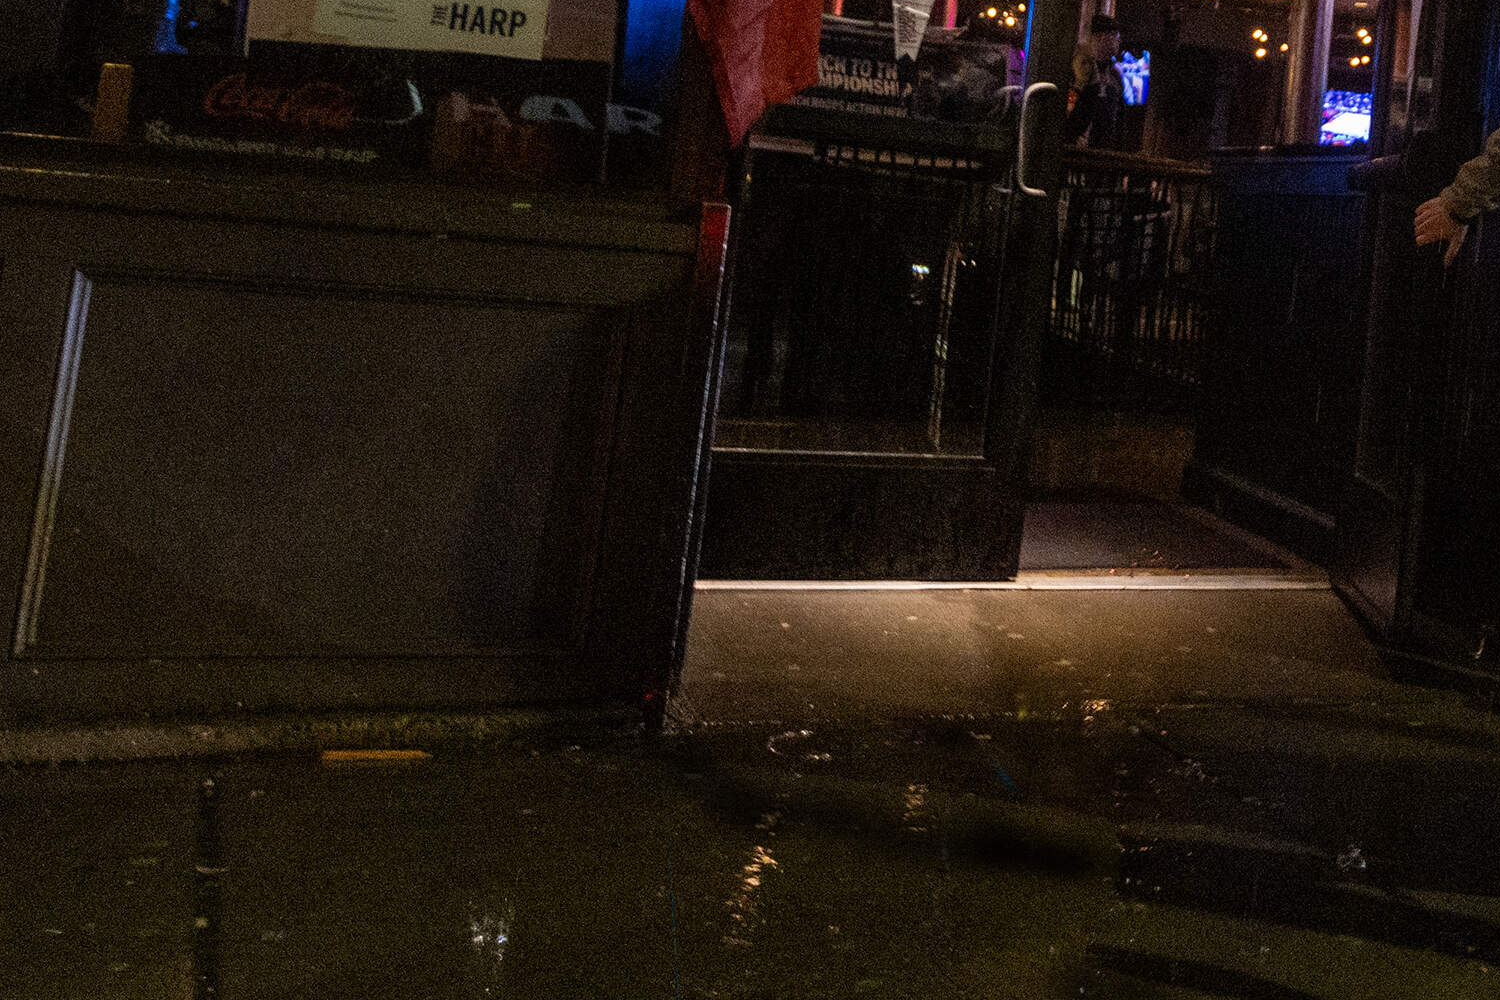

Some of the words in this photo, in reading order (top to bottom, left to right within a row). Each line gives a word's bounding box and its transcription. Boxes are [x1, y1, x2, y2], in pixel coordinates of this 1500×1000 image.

[449, 2, 527, 38] HARP
[850, 57, 872, 77] TO
[877, 60, 899, 81] TH
